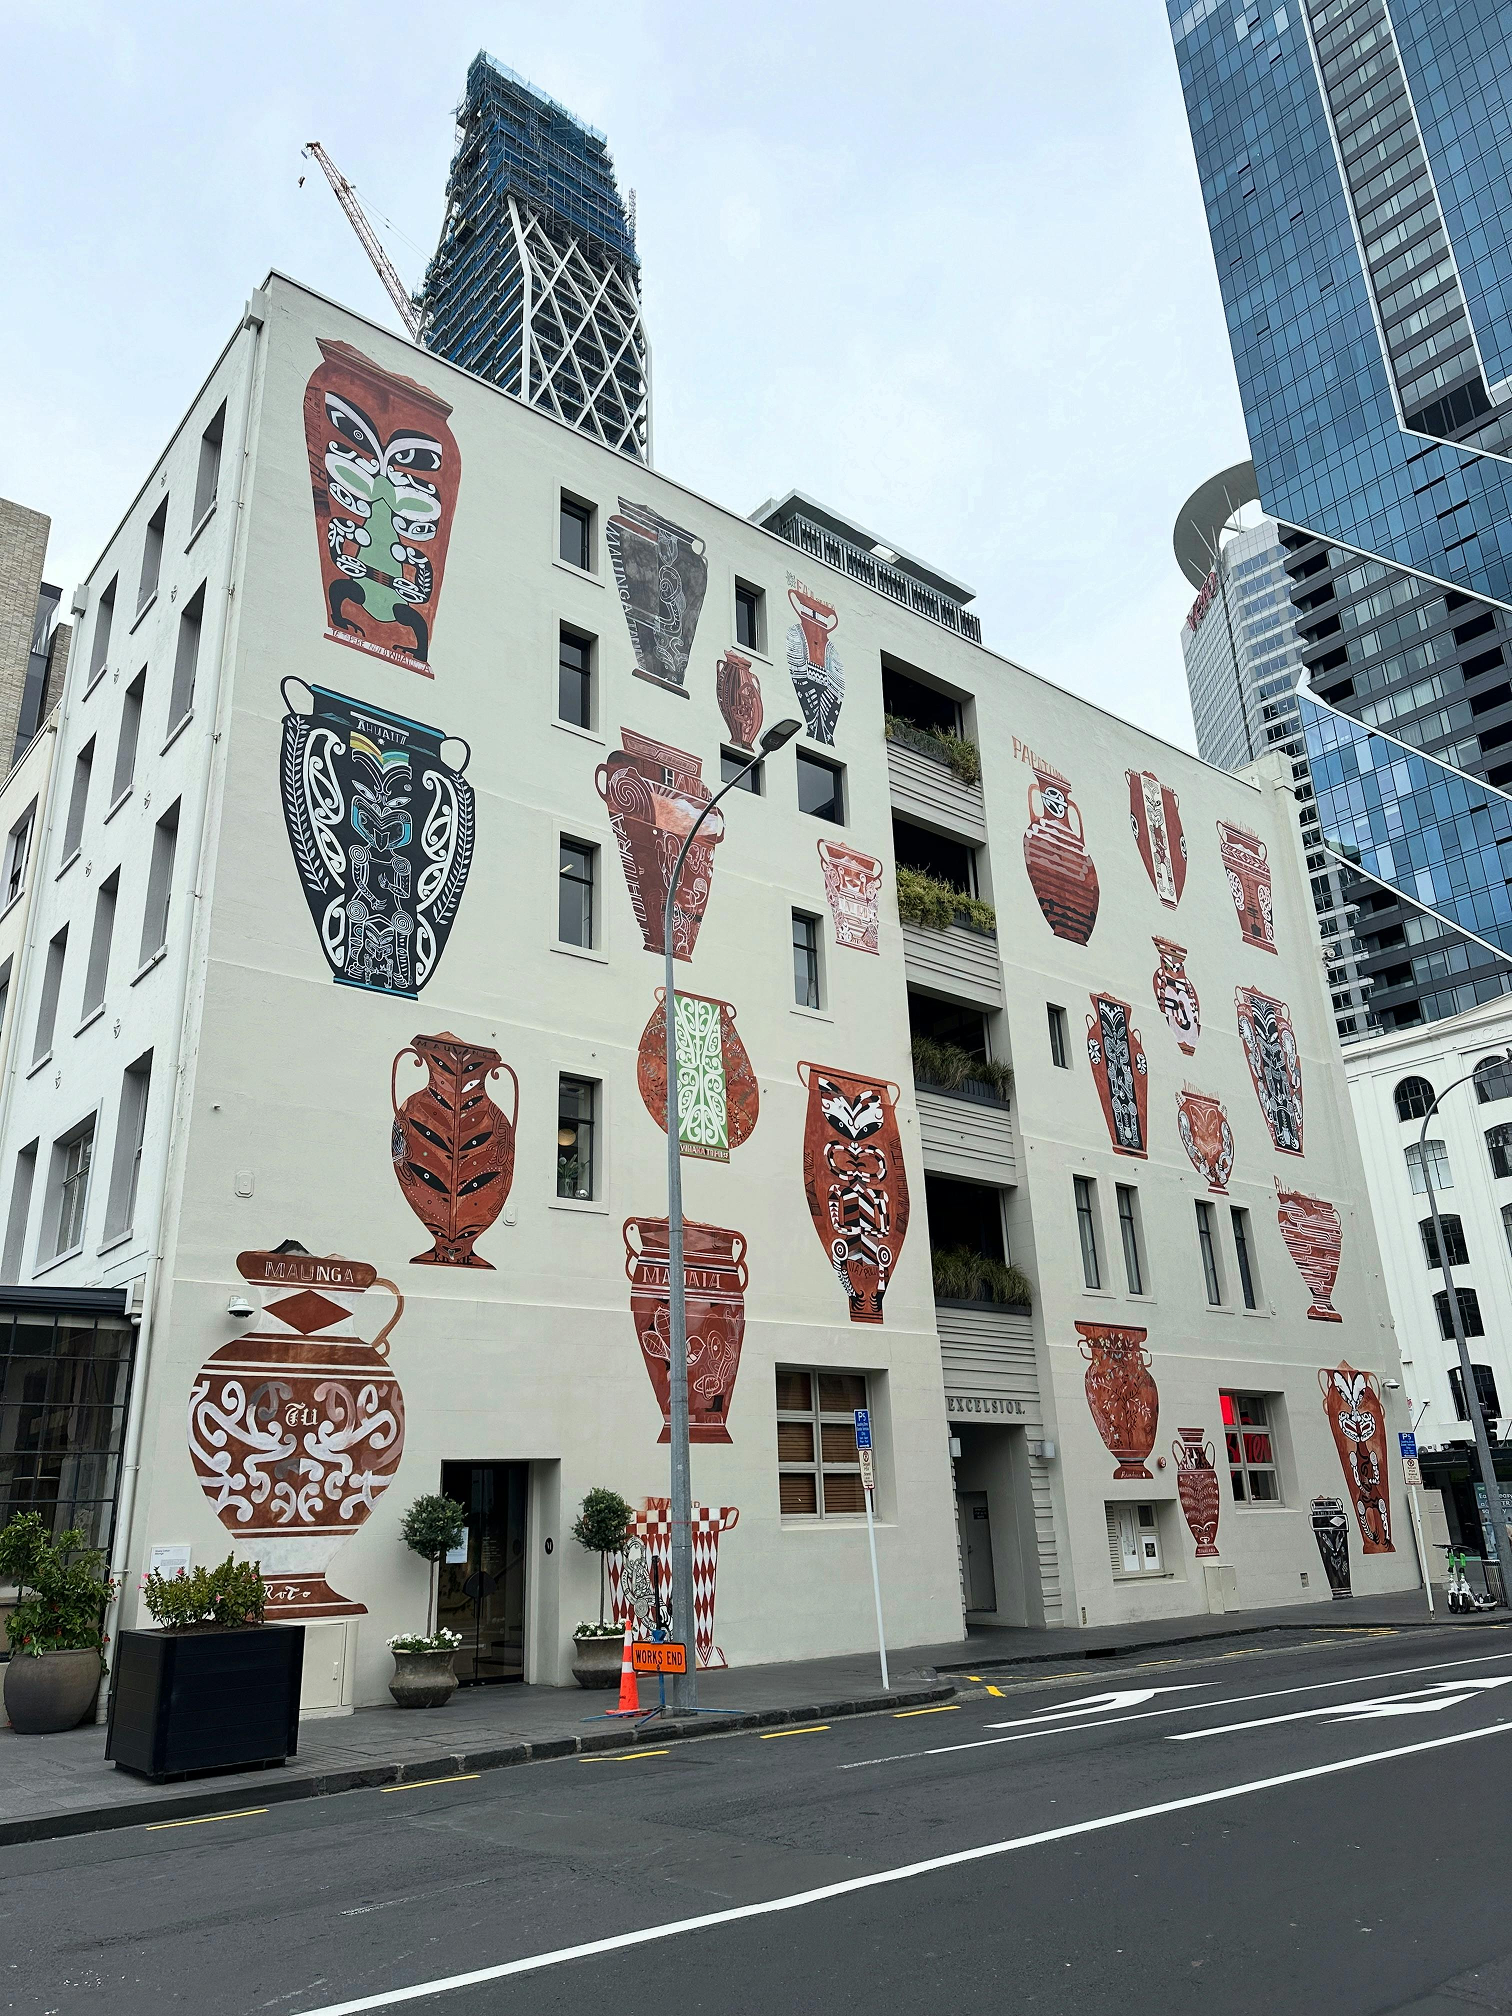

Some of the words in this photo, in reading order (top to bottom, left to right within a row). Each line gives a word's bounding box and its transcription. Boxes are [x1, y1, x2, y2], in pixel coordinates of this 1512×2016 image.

[264, 1261, 354, 1284] MAUNGA
[642, 1266, 724, 1290] MAAIA
[635, 1648, 663, 1666] WORKS
[666, 1651, 683, 1666] END
